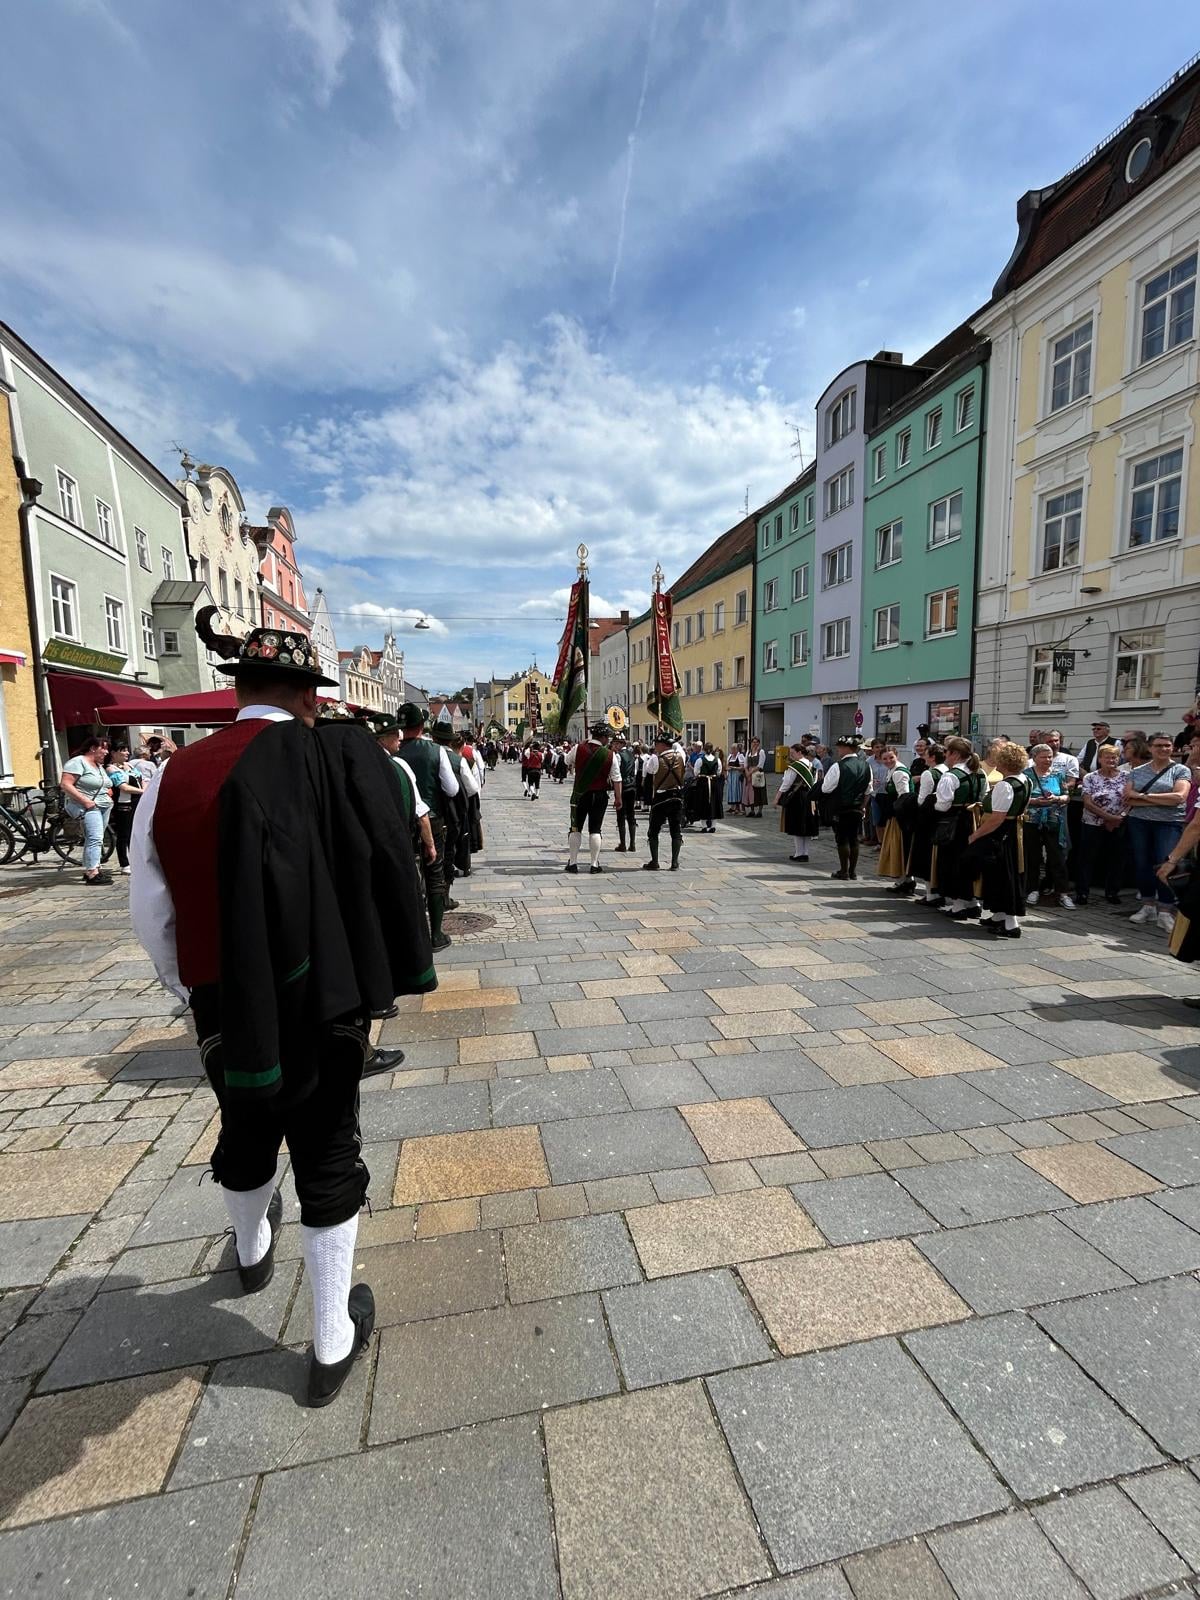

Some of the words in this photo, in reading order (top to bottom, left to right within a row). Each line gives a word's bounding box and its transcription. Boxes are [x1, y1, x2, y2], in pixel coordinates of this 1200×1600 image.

[44, 643, 59, 657] Eis
[61, 646, 96, 666] Gelateria
[1055, 655, 1073, 667] vhs
